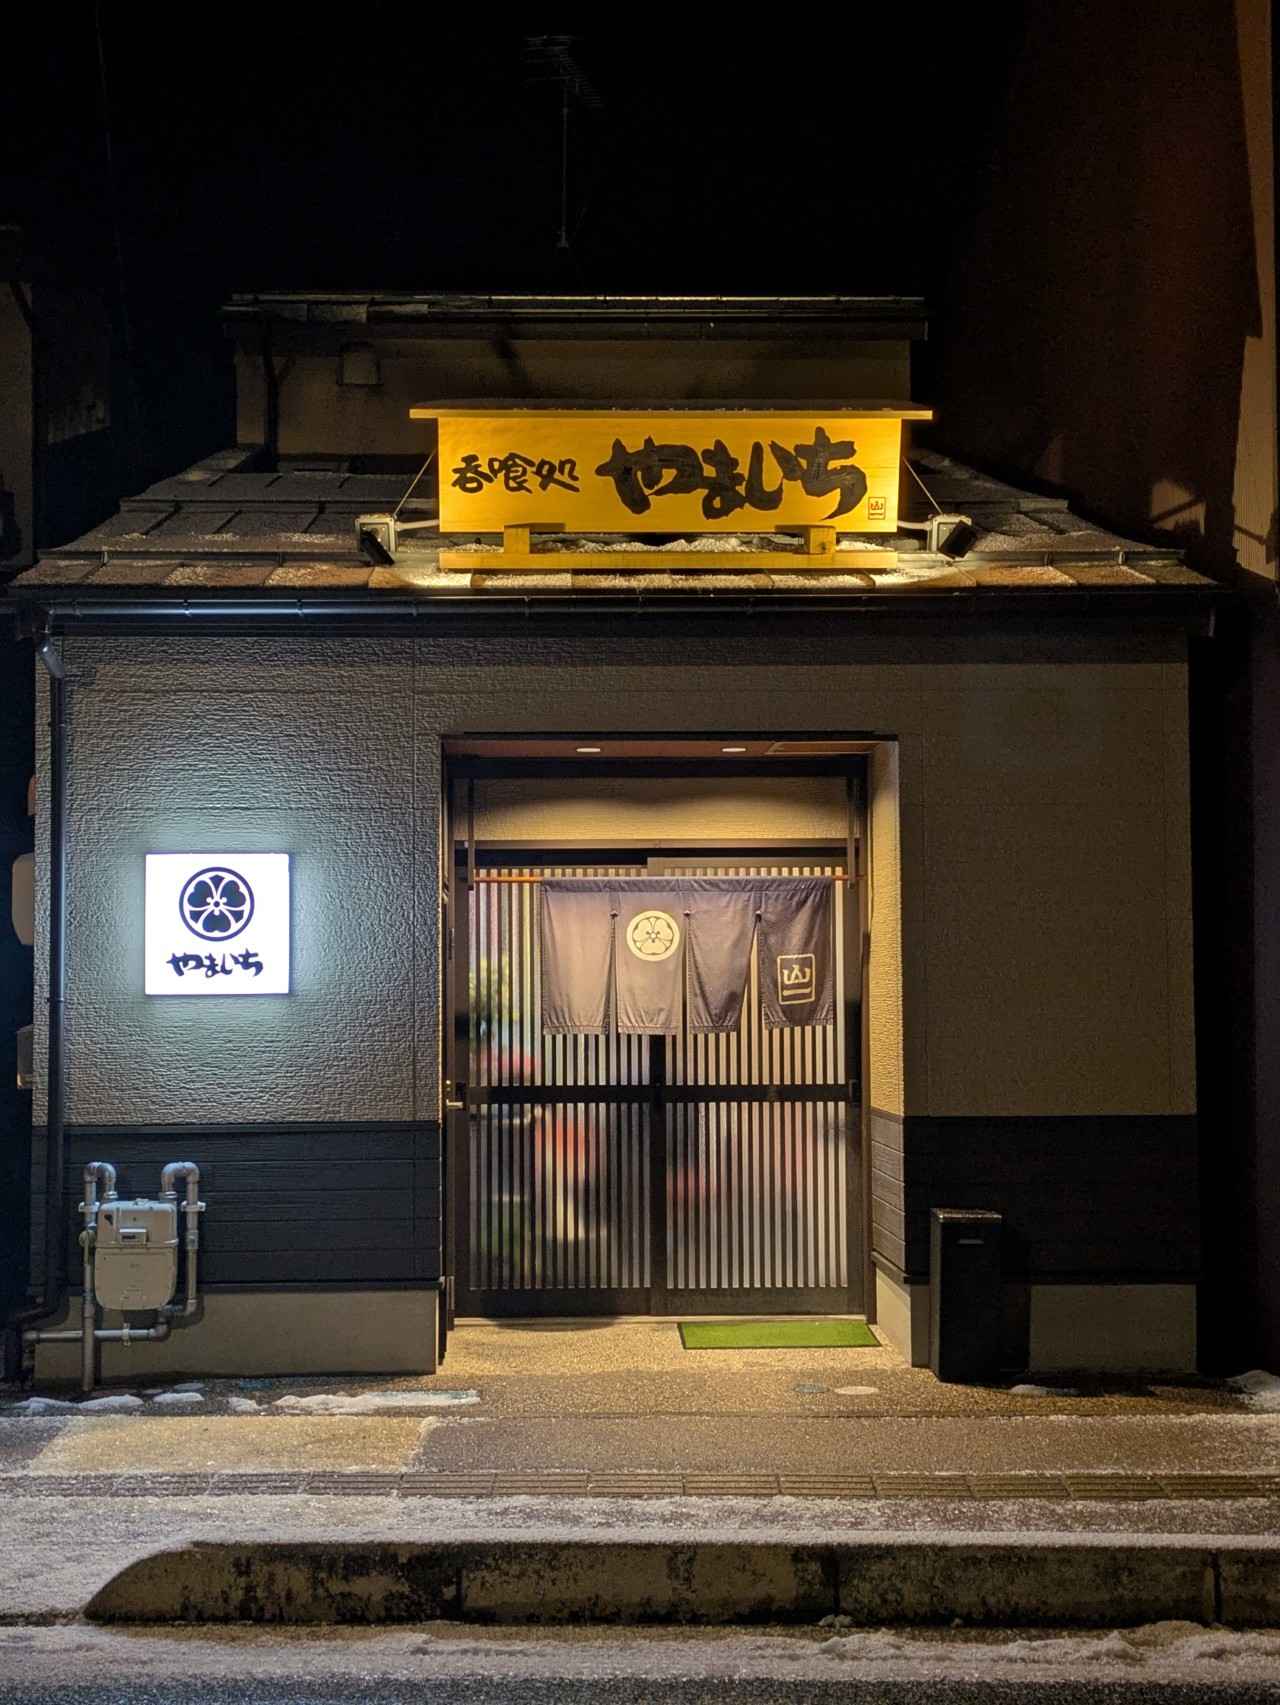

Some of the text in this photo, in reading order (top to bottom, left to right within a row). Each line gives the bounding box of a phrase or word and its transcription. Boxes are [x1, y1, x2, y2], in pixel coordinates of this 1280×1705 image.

[451, 426, 867, 521] 呑喰処 やまいち
[166, 948, 264, 978] やまいち
